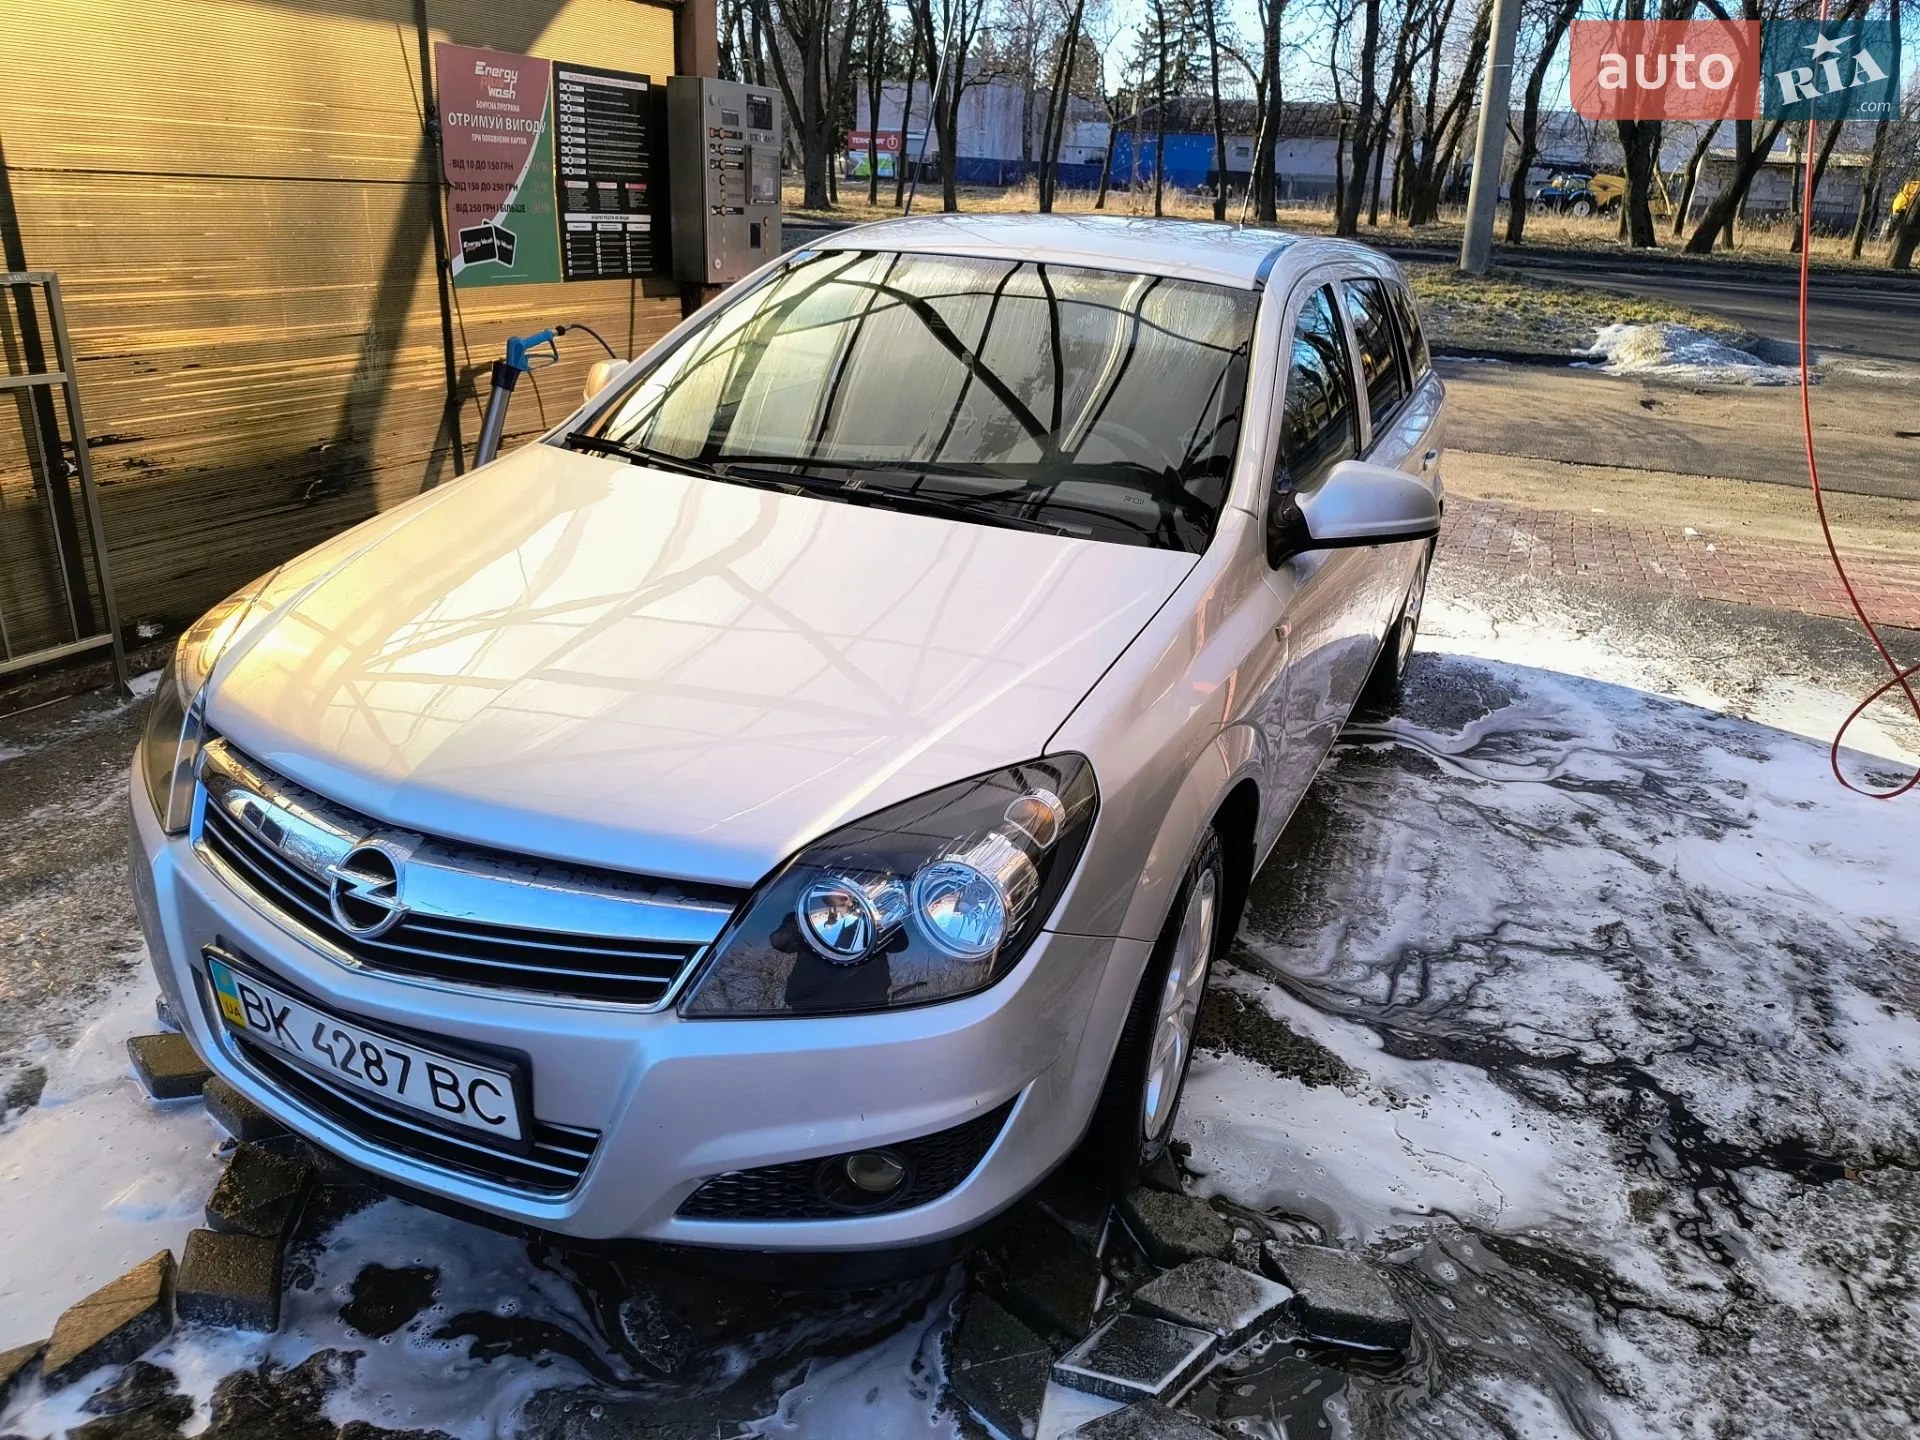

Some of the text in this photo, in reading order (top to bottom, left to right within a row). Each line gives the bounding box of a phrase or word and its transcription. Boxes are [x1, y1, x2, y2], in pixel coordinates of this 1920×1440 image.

[475, 61, 518, 83] Energy
[488, 81, 516, 99] wash
[448, 112, 546, 135] ОТРИМУЙ ВИГОДУ
[452, 159, 465, 170] ВІД
[466, 160, 474, 169] 10
[475, 160, 486, 171] ДО
[488, 161, 499, 170] 150
[500, 161, 514, 171] ГРН
[468, 182, 479, 191] 150
[480, 183, 491, 192] ДО
[455, 203, 468, 214] ВІД
[482, 204, 495, 213] ГРН
[226, 999, 243, 1018] UA
[238, 982, 507, 1126] BK 4287 BC
